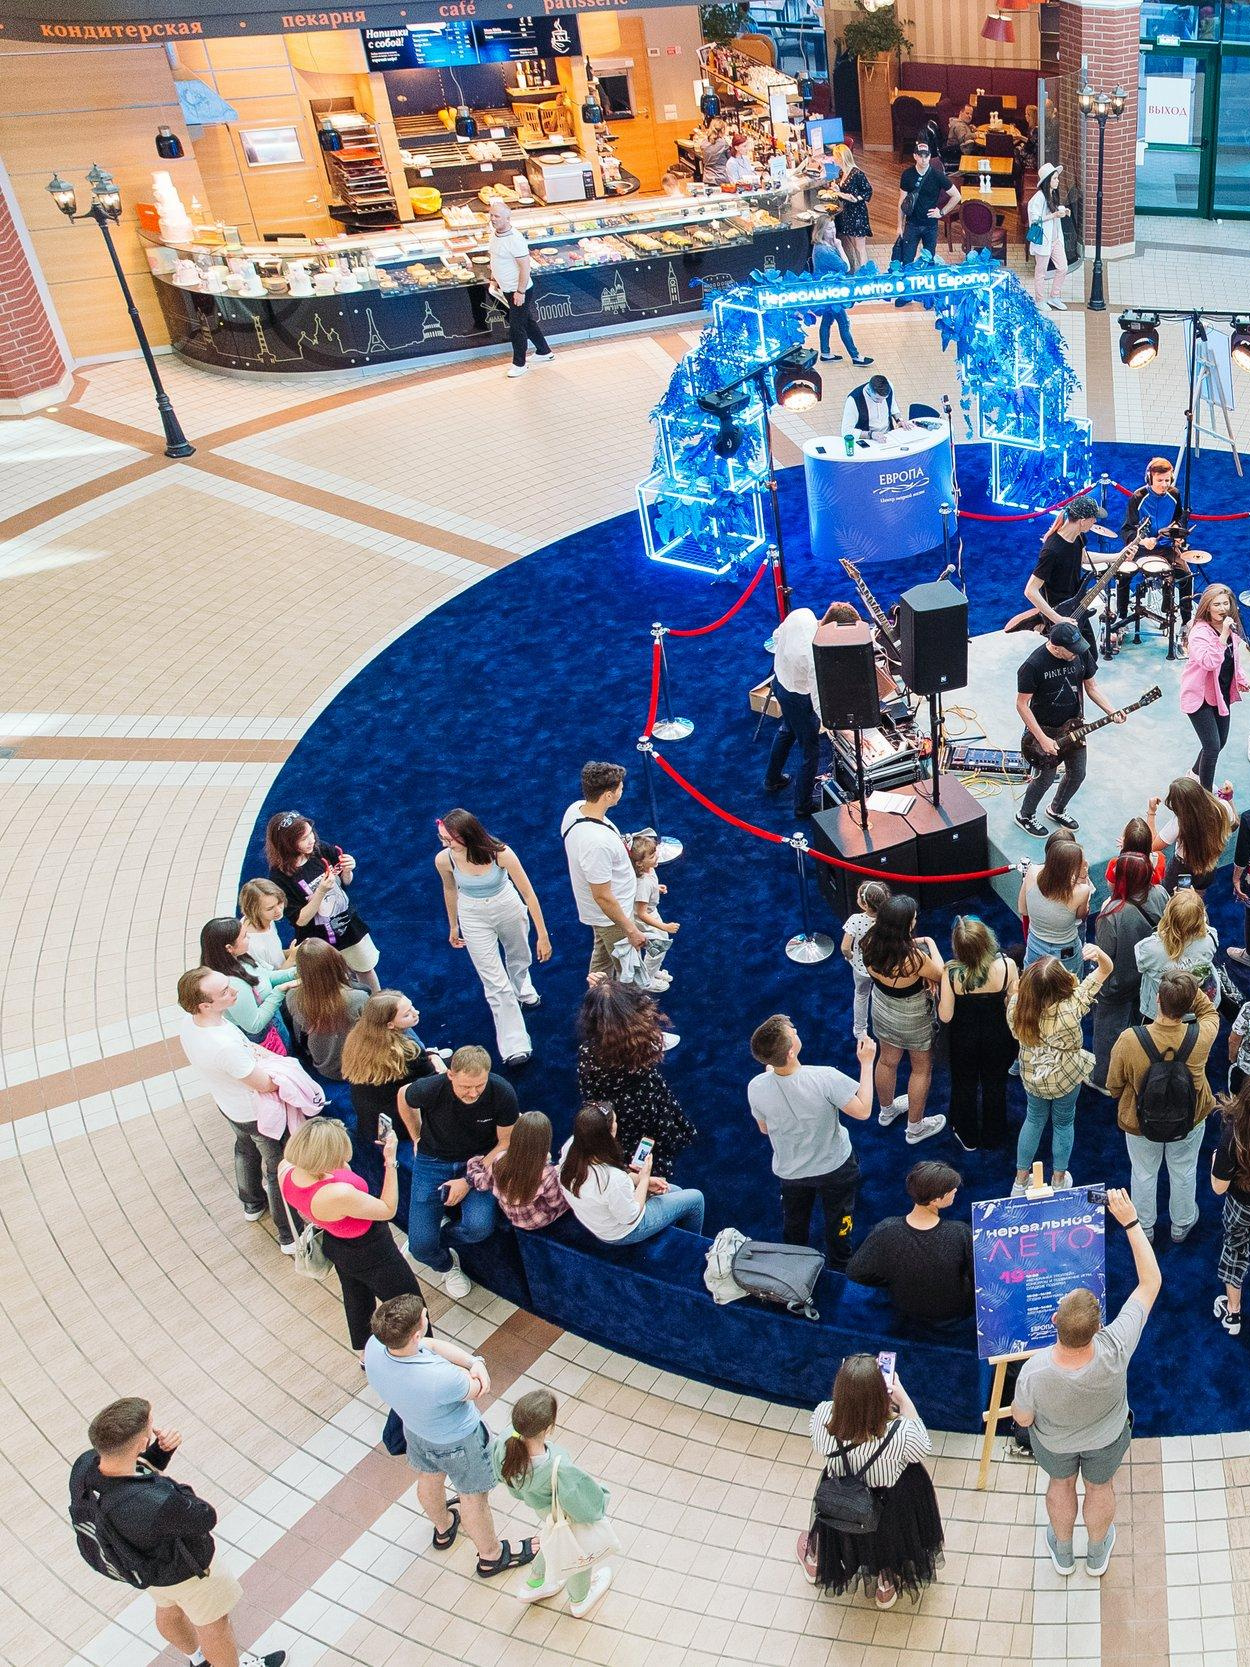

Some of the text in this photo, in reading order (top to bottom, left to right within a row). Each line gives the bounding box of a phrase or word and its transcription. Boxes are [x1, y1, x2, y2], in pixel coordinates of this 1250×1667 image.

[439, 1, 476, 17] café
[281, 10, 367, 29] пекарня
[41, 21, 203, 43] кондитерская
[366, 28, 408, 39] Напитки
[374, 37, 405, 48] собой!
[1148, 105, 1188, 117] ВЫХОД
[758, 272, 990, 306] Нереальное лето в ТРЦ Европа
[879, 466, 925, 486] ЕВРОПА
[1043, 667, 1062, 680] PINK
[986, 1214, 1093, 1238] нереальное
[988, 1225, 1095, 1262] ЛЕТО
[999, 1268, 1025, 1284] 19
